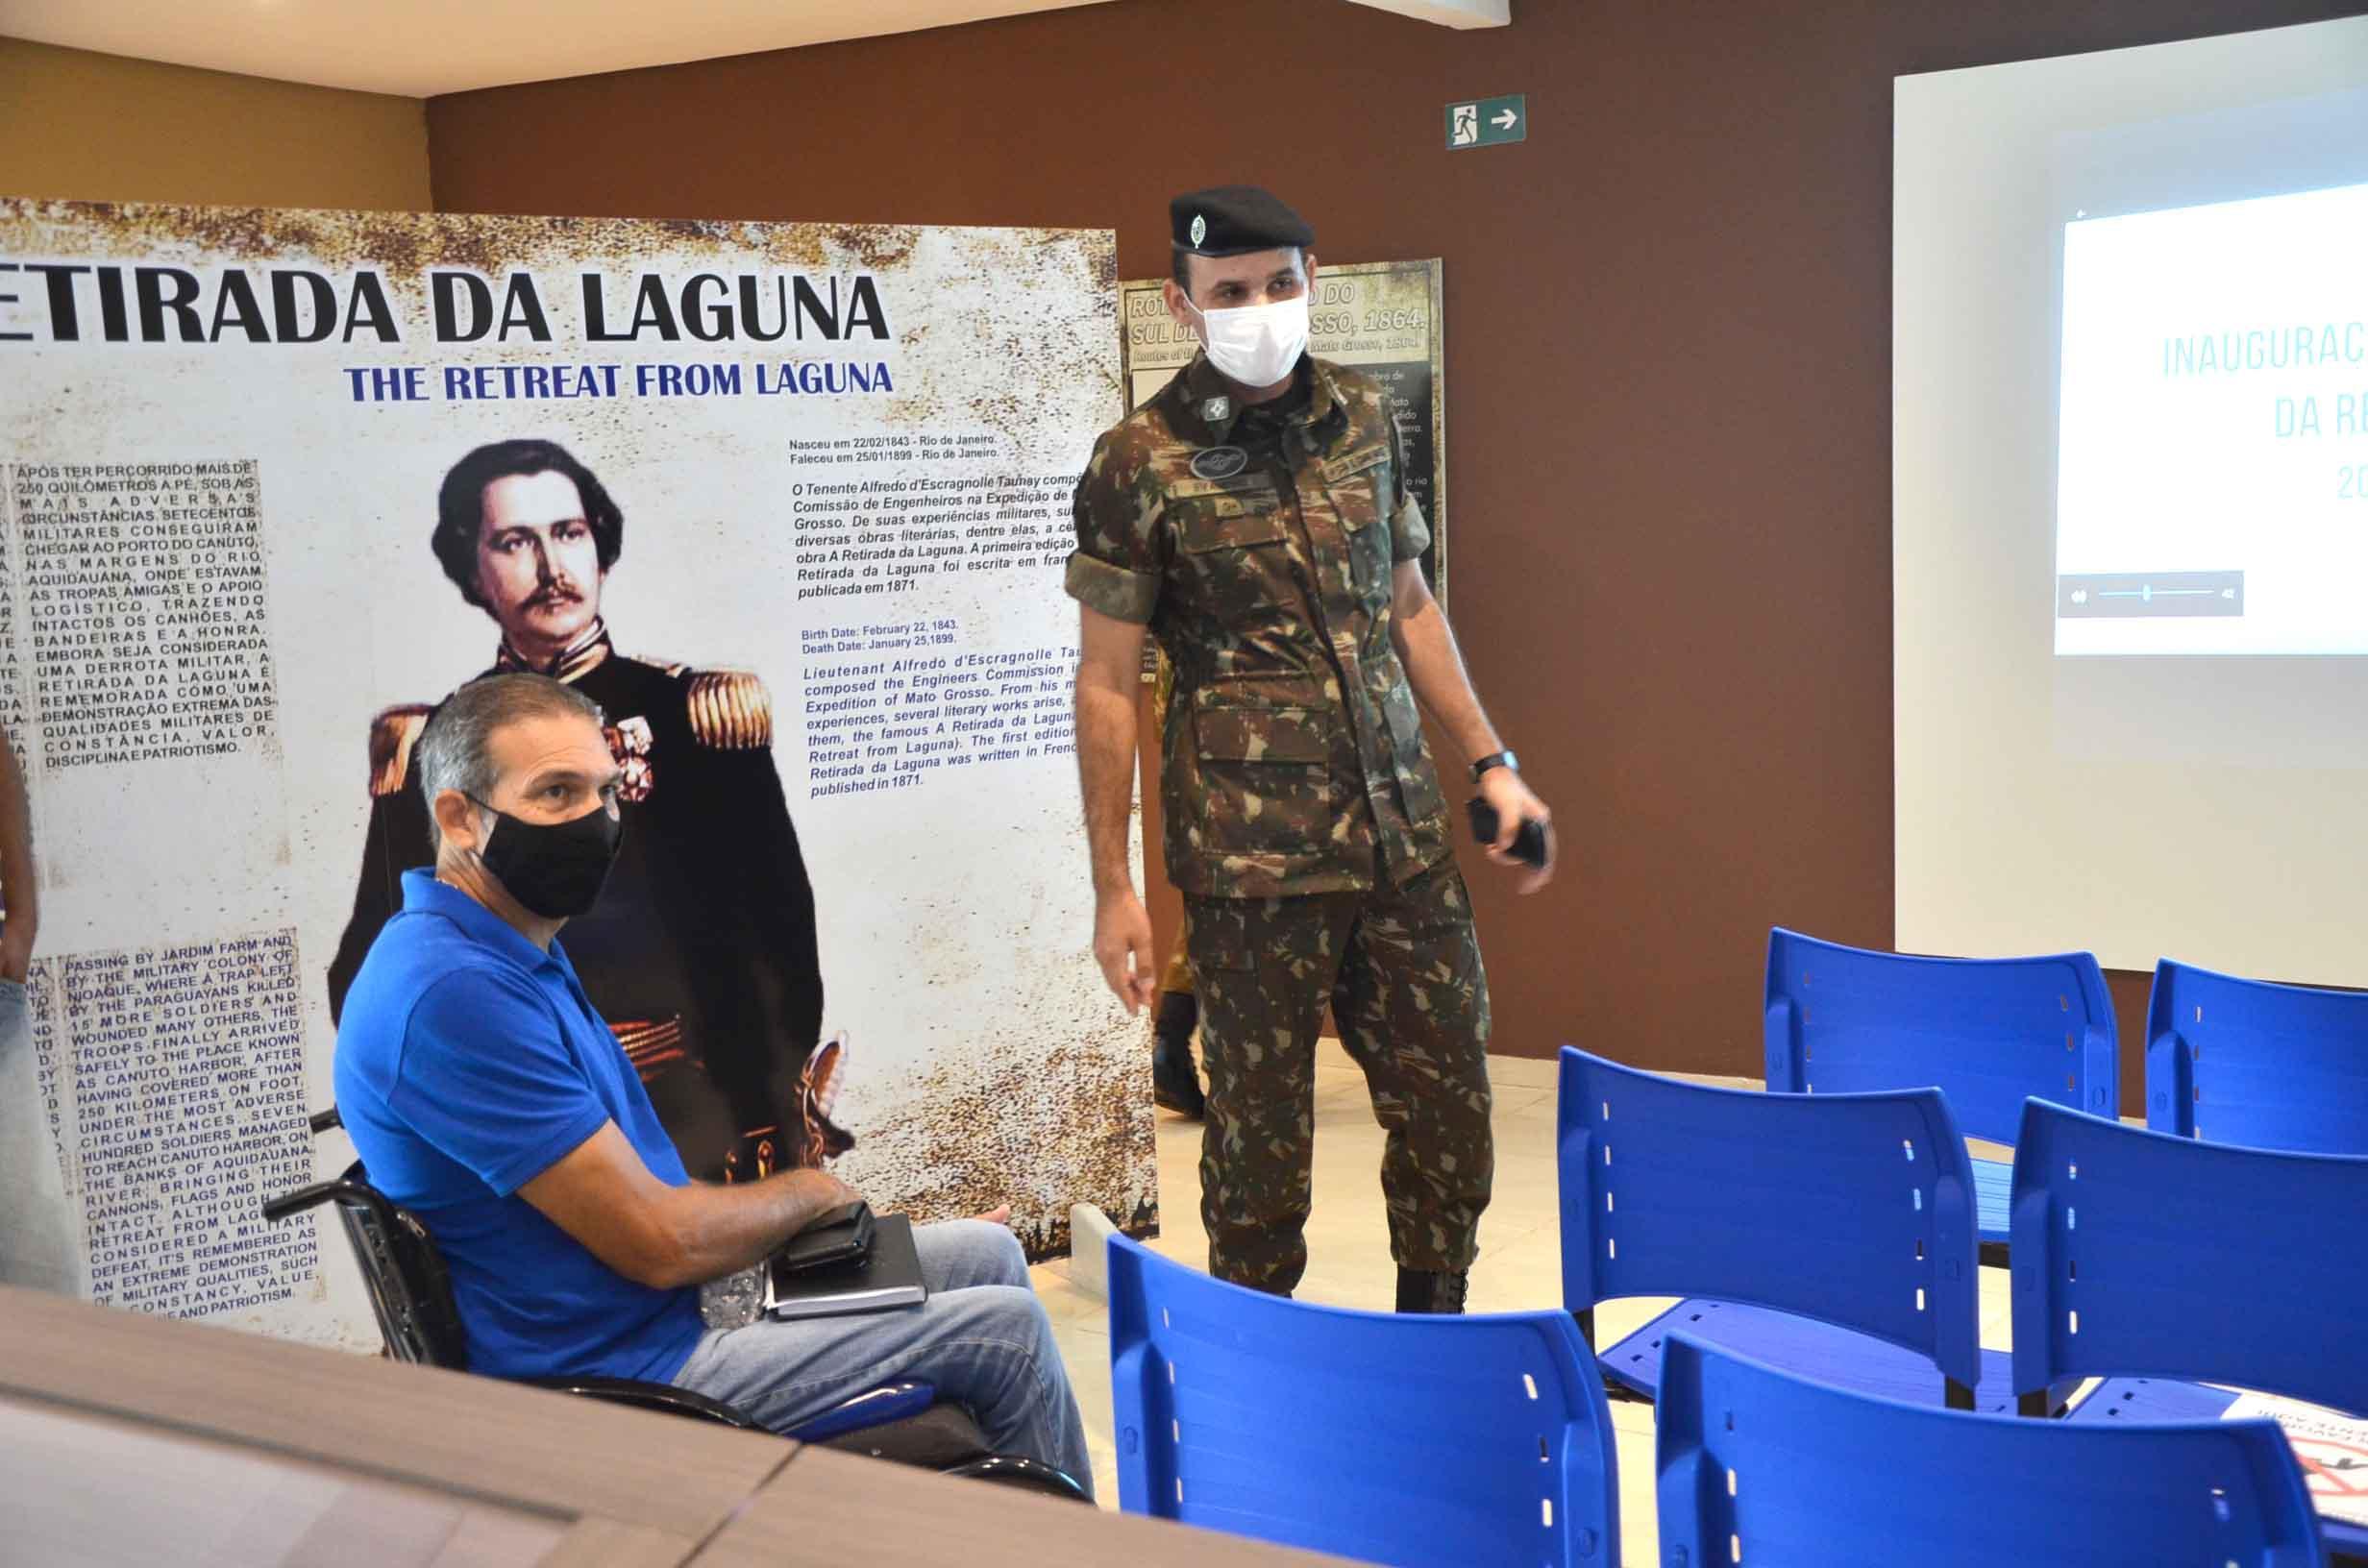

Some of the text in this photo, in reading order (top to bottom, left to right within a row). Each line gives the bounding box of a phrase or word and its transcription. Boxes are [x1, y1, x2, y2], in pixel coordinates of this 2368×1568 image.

[432, 272, 553, 342] DA
[581, 273, 891, 342] LAGUNA
[1132, 322, 1170, 345] SUL
[343, 362, 894, 402] THE RETREAT FROM LAGUNA
[2275, 395, 2322, 438] DA
[789, 439, 830, 451] Nasceu
[852, 437, 909, 449] 22/02/1843
[919, 436, 937, 447] Rio
[939, 436, 952, 446] de
[955, 435, 997, 446] Janeiro.
[790, 453, 833, 464] Faleceu
[855, 451, 912, 462] 25/01/1899
[922, 450, 940, 460] Rio
[942, 450, 955, 459] de
[957, 449, 999, 459] Janeiro.
[792, 483, 802, 495] O
[805, 481, 857, 495] Tenente
[859, 479, 907, 493] Alfredo
[909, 477, 994, 494] d'Escragnolle
[995, 475, 1040, 490] Taunay
[792, 499, 859, 513] Comissão
[862, 498, 878, 509] de
[882, 494, 963, 511] Engenheiros
[967, 495, 982, 504] na
[985, 489, 1049, 506] Expedição
[1052, 489, 1067, 501] de
[794, 515, 846, 529] Grosso.
[851, 514, 869, 527] De
[875, 515, 905, 526] suas
[911, 509, 990, 527] experiências
[996, 506, 1051, 522] militares,
[23, 522, 258, 540] MILITARES CONSEGUIRAM
[796, 538, 1073, 563] obra A Retirada da Laguna. A primeira edição
[144, 569, 189, 580] ONDE
[195, 566, 262, 578] ESTAVAM
[798, 579, 919, 600] publicada em 1871.
[161, 596, 263, 610] TRAZENDO
[32, 617, 114, 631] INTACTOS
[124, 616, 145, 626] OS
[243, 609, 264, 621] AS
[801, 621, 958, 640] Birth Date: February 22, 1843.
[34, 631, 145, 647] BANDEIRAS
[157, 630, 165, 640] E
[178, 628, 186, 639] A
[802, 642, 834, 654] Death
[837, 640, 865, 651] Date:
[868, 637, 911, 651] January
[36, 639, 267, 662] EMBORA SEJA CONSIDERADA
[37, 665, 75, 677] UMA
[85, 659, 167, 674] DERROTA
[259, 652, 270, 663] A
[803, 661, 884, 679] Lieutenant
[892, 656, 946, 672] Alfredo
[953, 648, 1051, 670] d'Escragnolle
[38, 666, 269, 692] RETIRADA DA LAGUNA É
[804, 678, 876, 698] composed
[883, 675, 904, 689] the
[912, 670, 977, 689] Engineers
[985, 663, 1063, 681] Commission
[42, 711, 273, 738] QUALIDADES MILITARES DE
[807, 731, 845, 747] them,
[852, 728, 873, 742] the
[880, 723, 928, 739] famous
[935, 722, 945, 734] A
[951, 717, 1003, 733] Retirada
[1011, 715, 1026, 727] da
[809, 745, 859, 761] Retreat
[866, 742, 898, 756] from
[970, 733, 995, 747] The
[1001, 730, 1026, 745] first
[811, 772, 923, 796] published in 1871.
[64, 936, 292, 972] PASSING BY JARDIM FARM AND
[68, 978, 295, 1017] BY THE PARAGUAYANS KILLED
[71, 1026, 147, 1045] WOUNDED
[155, 1019, 195, 1035] MANY
[273, 1007, 297, 1019] THE
[77, 1062, 302, 1104] HAVING COVERED MORE THAN
[82, 1117, 308, 1164] HUNDRED SOLDIERS MANAGED
[159, 1252, 184, 1266] IT'S
[192, 1232, 290, 1260] REMEMBERED
[297, 1228, 315, 1241] AS
